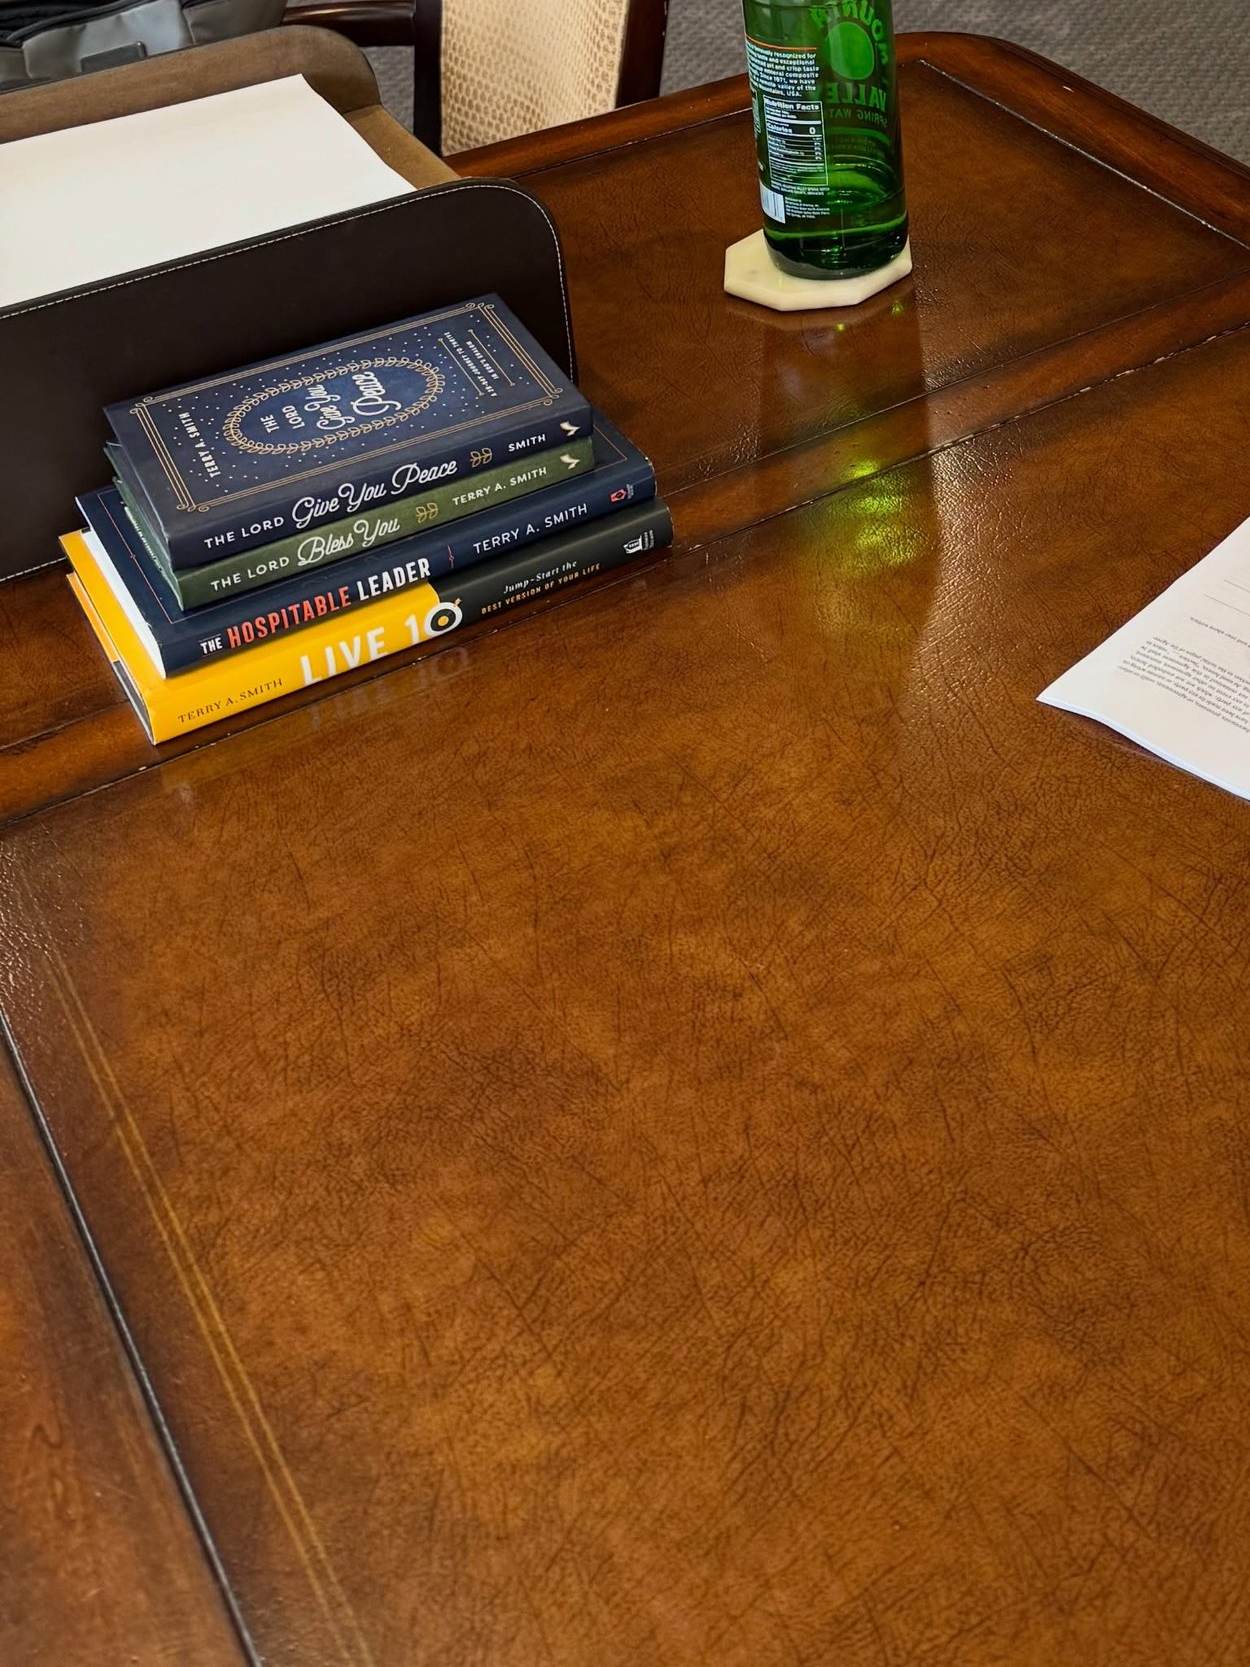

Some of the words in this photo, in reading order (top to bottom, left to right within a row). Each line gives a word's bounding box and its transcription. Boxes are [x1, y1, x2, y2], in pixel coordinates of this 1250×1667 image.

[796, 103, 819, 111] Facts
[303, 384, 341, 412] You
[350, 371, 402, 416] Peace
[178, 412, 200, 439] SMITH
[260, 413, 280, 434] THE
[282, 405, 306, 429] LORD
[316, 405, 355, 430] Give
[198, 451, 222, 478] TERRY
[203, 531, 235, 549] THE
[241, 516, 285, 538] LORD
[292, 496, 340, 529] Give
[337, 482, 387, 512] You
[390, 462, 457, 495] Peace
[508, 434, 546, 452] SMITH
[210, 573, 242, 592] THE
[248, 556, 290, 579] LORD
[297, 532, 354, 567] Bless
[353, 518, 401, 547] You
[452, 486, 491, 506] TERRY
[494, 480, 506, 492] A.
[509, 467, 548, 486] SMITH
[200, 636, 223, 655] THE
[226, 586, 352, 649] HOSPITABLE
[356, 557, 431, 602] LEADER
[472, 528, 520, 555] TERRY
[525, 523, 540, 535] A.
[544, 503, 588, 529] SMITH
[481, 601, 503, 615] BEST
[505, 586, 542, 606] VERSION
[544, 581, 555, 591] OF
[558, 571, 580, 585] YOUR
[582, 563, 601, 576] LIFE
[503, 567, 561, 595] Jump-Start
[562, 560, 578, 572] the
[177, 700, 222, 724] TERRY
[300, 626, 389, 687] LIVE
[404, 600, 463, 645] 10
